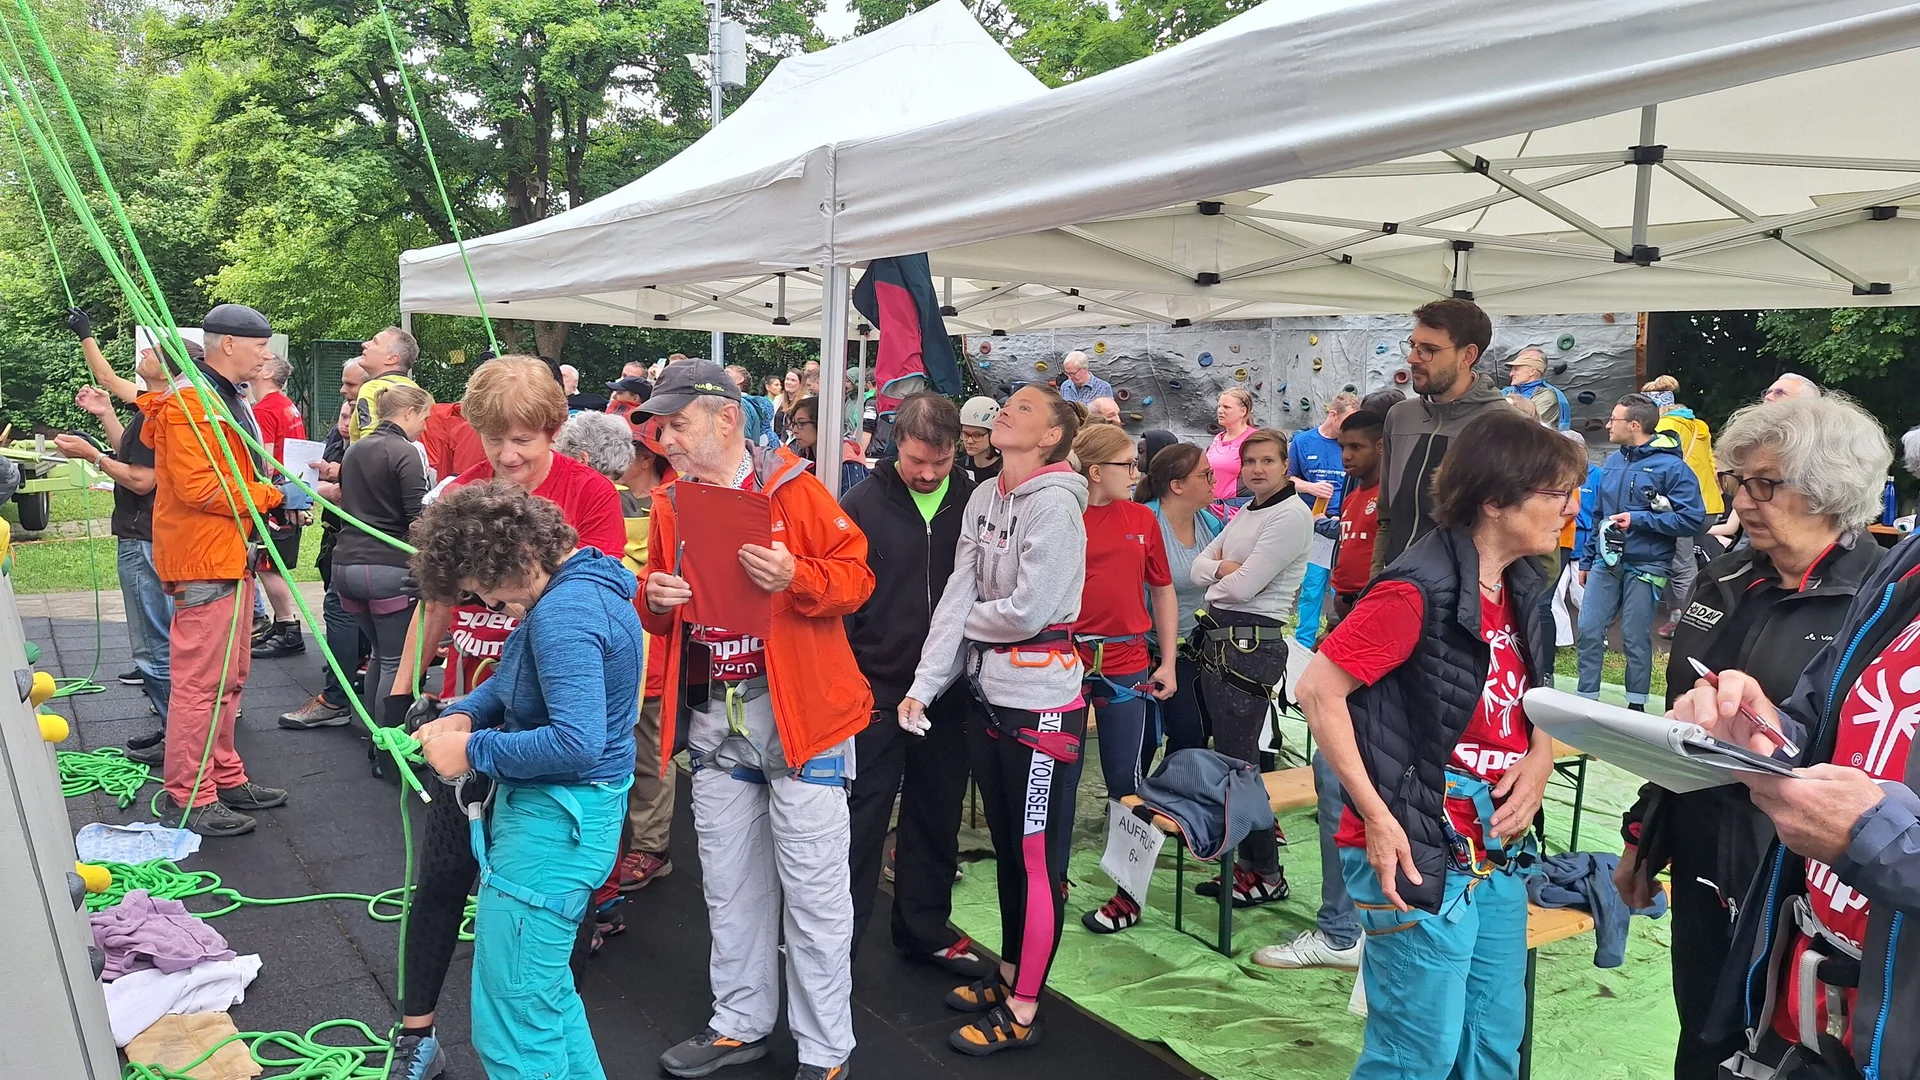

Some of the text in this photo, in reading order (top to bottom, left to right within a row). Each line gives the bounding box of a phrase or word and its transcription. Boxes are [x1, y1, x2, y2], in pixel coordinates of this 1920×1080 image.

[1697, 607, 1722, 621] DAV
[1026, 758, 1055, 827] YOURSELF
[1118, 815, 1156, 853] AUFRUF
[1128, 848, 1139, 864] 6+
